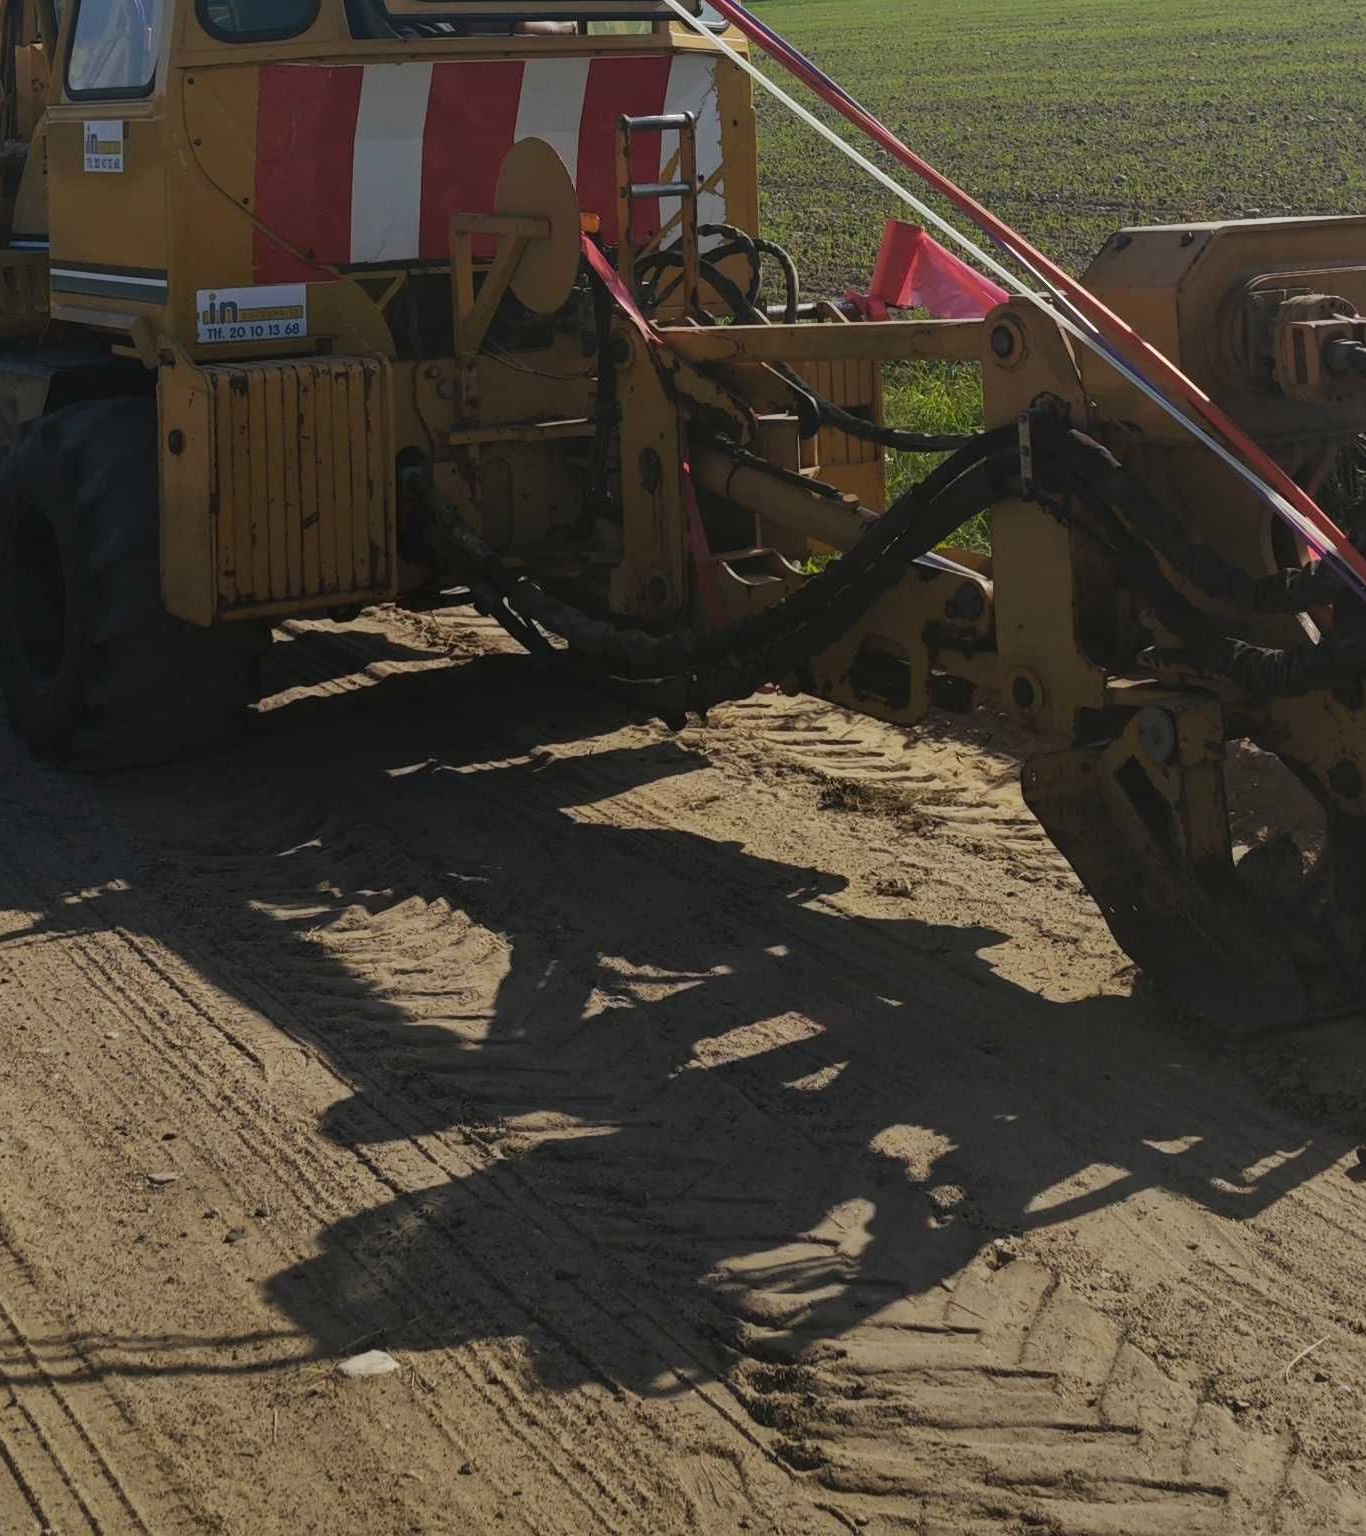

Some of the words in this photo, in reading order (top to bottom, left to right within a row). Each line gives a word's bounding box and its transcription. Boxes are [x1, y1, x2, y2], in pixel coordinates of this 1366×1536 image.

[206, 328, 225, 340] Tlf.
[229, 326, 246, 338] 20
[250, 325, 264, 337] 10
[268, 323, 281, 336] 13
[285, 322, 300, 335] 68
